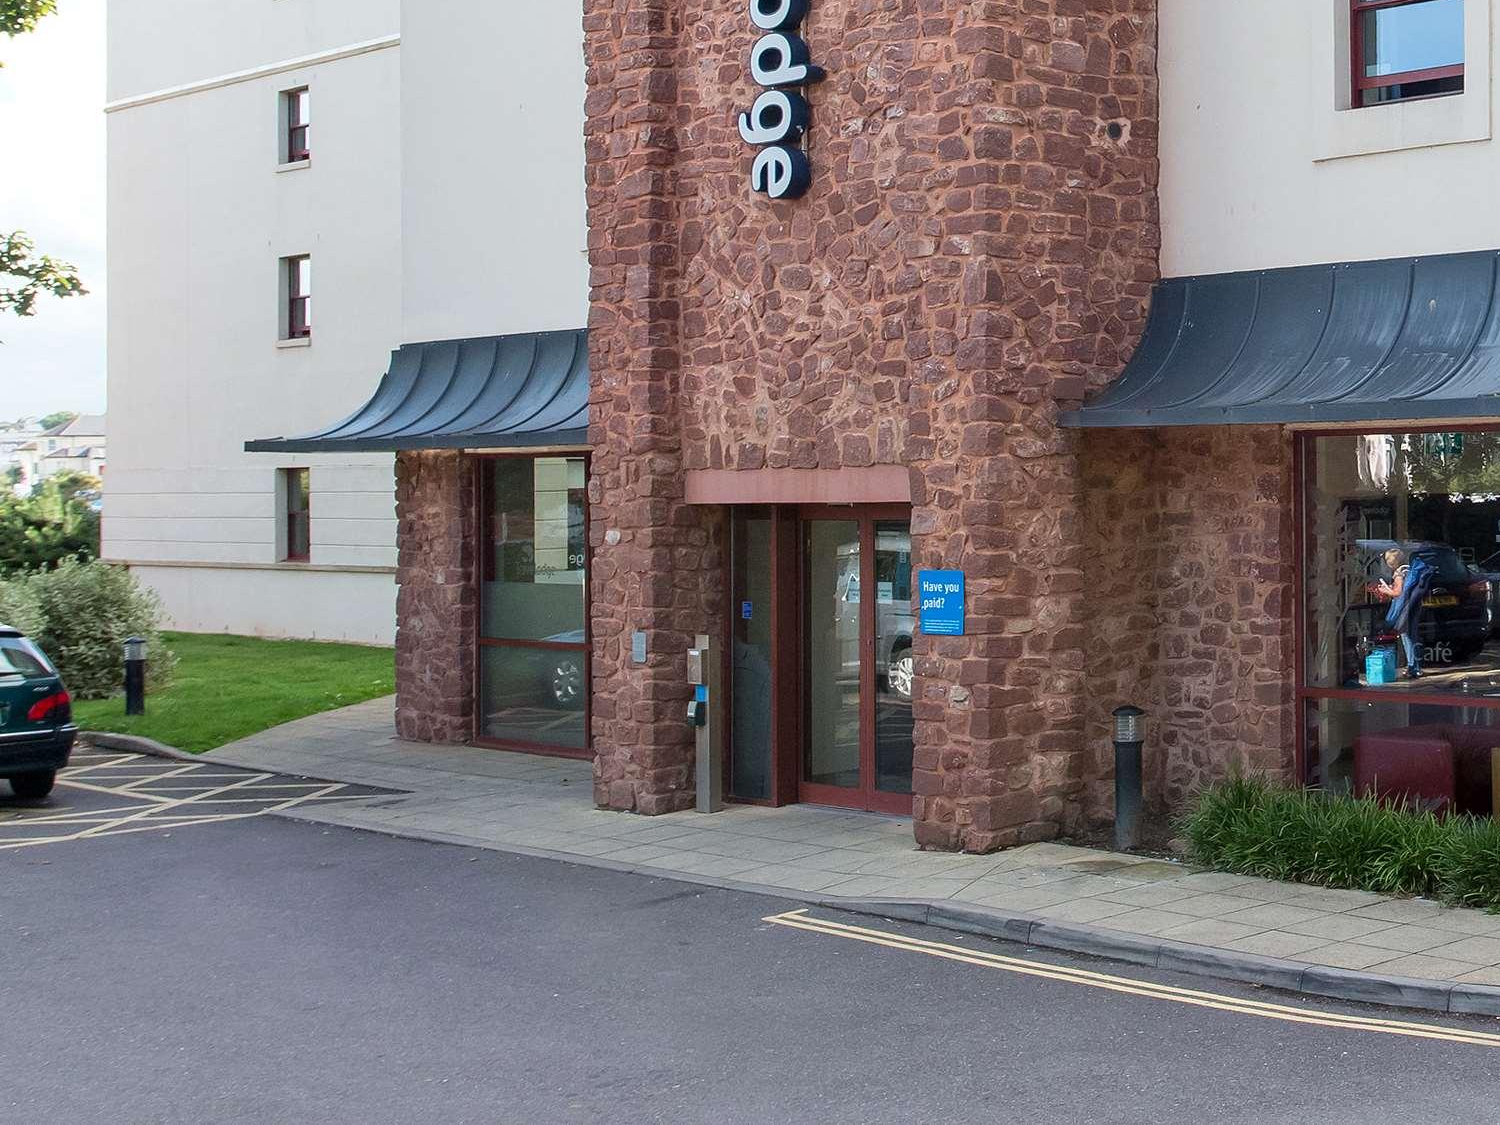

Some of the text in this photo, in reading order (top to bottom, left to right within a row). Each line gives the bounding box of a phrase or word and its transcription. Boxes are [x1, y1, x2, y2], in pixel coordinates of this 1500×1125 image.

[923, 581, 960, 594] Have you
[923, 597, 945, 611] paid?
[1413, 641, 1453, 663] Café
